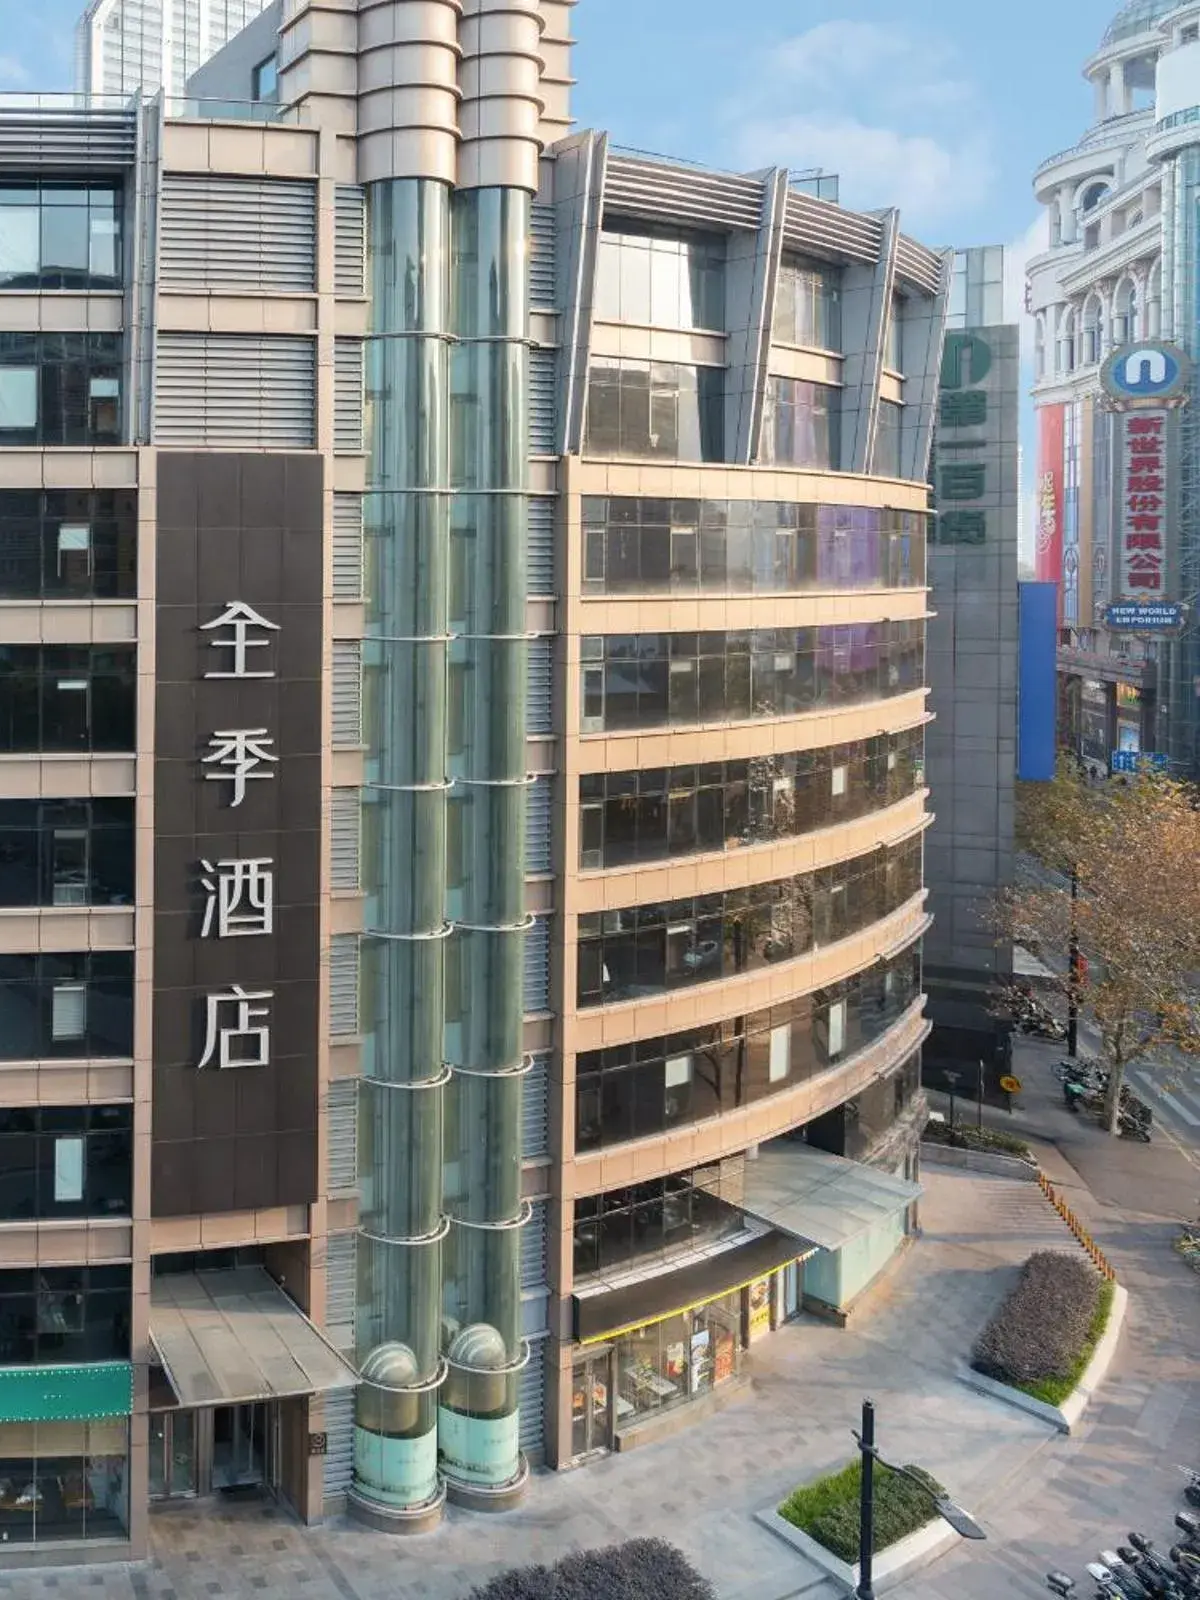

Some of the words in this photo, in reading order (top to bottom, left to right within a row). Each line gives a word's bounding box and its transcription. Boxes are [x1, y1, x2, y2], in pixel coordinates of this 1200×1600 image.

[1126, 416, 1164, 590] 新世界股份有限公司
[1138, 607, 1177, 615] WORLD
[199, 600, 282, 1069] 全季酒店
